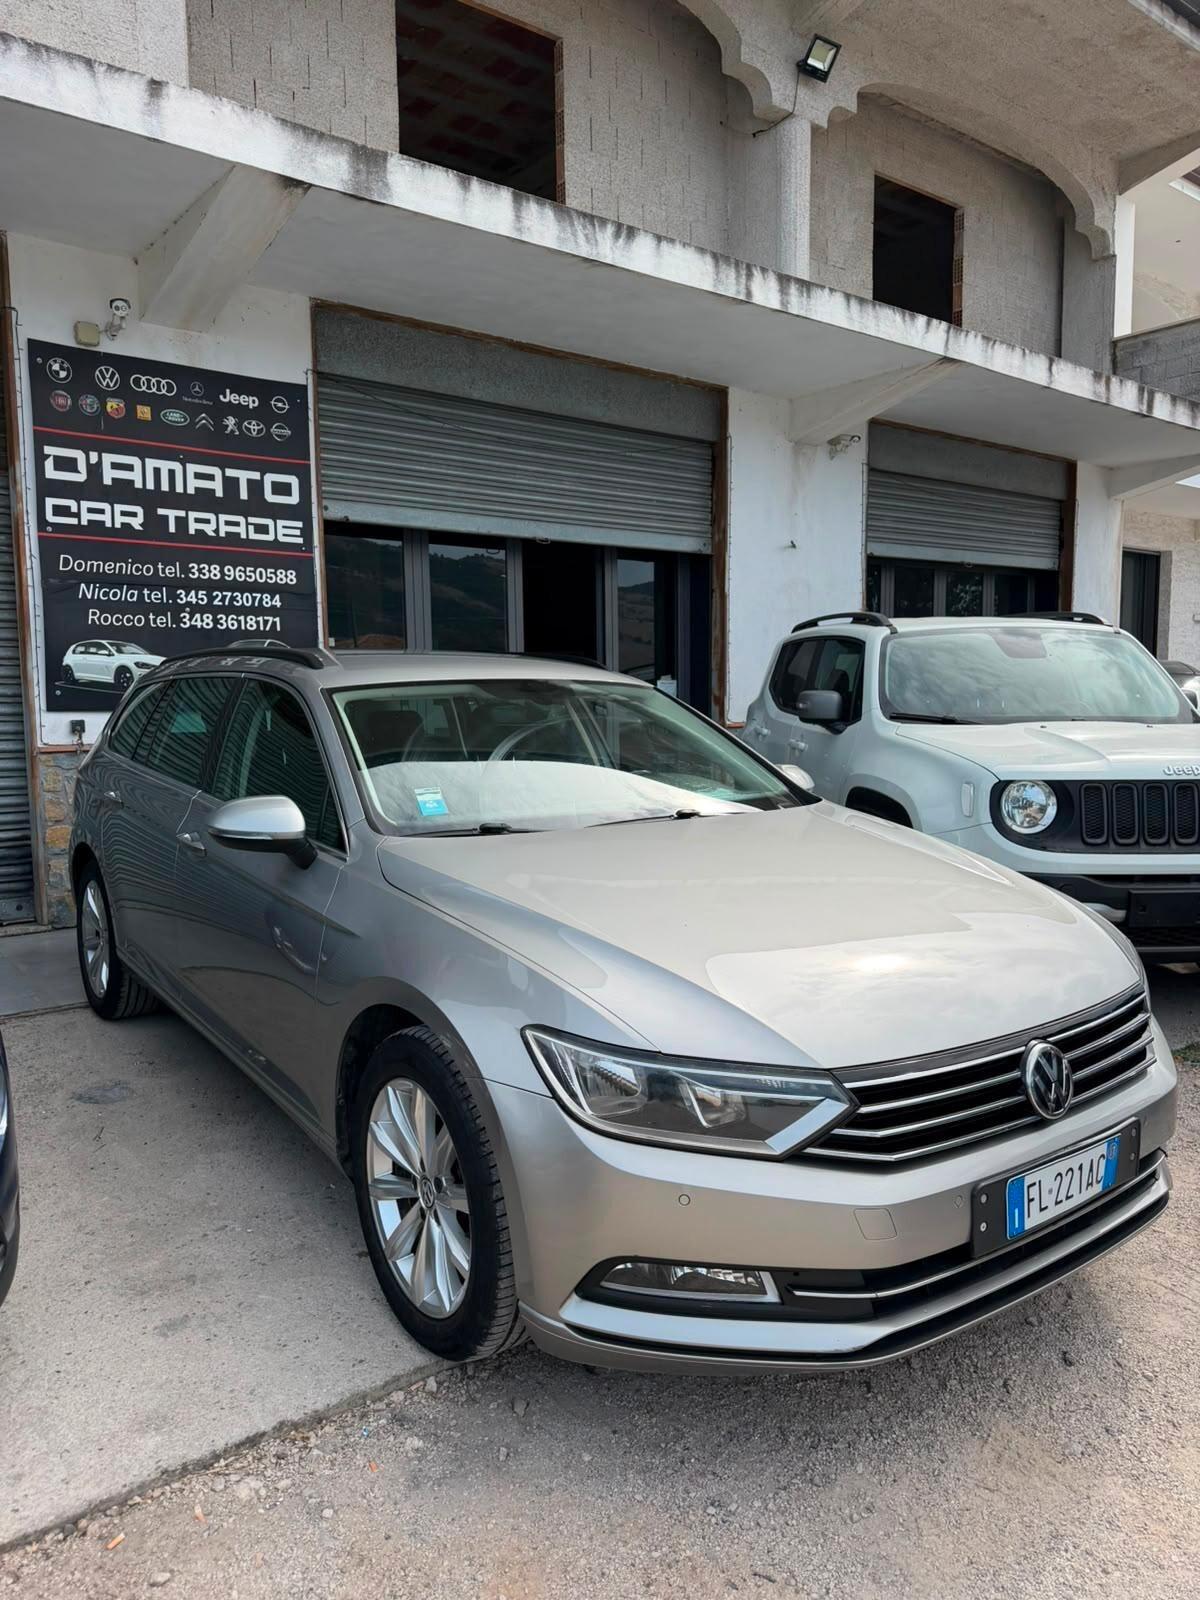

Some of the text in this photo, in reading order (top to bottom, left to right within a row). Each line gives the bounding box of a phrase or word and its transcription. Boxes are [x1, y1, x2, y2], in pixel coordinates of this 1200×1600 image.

[219, 388, 259, 409] Jeep
[43, 445, 300, 505] D'AMATO
[45, 497, 304, 544] CAR TRADE
[59, 554, 297, 584] Domenico tel. 338 9650588
[78, 583, 282, 608] Nicola tel. 345 2730784
[88, 609, 281, 632] Rocco tel. 348 3618171
